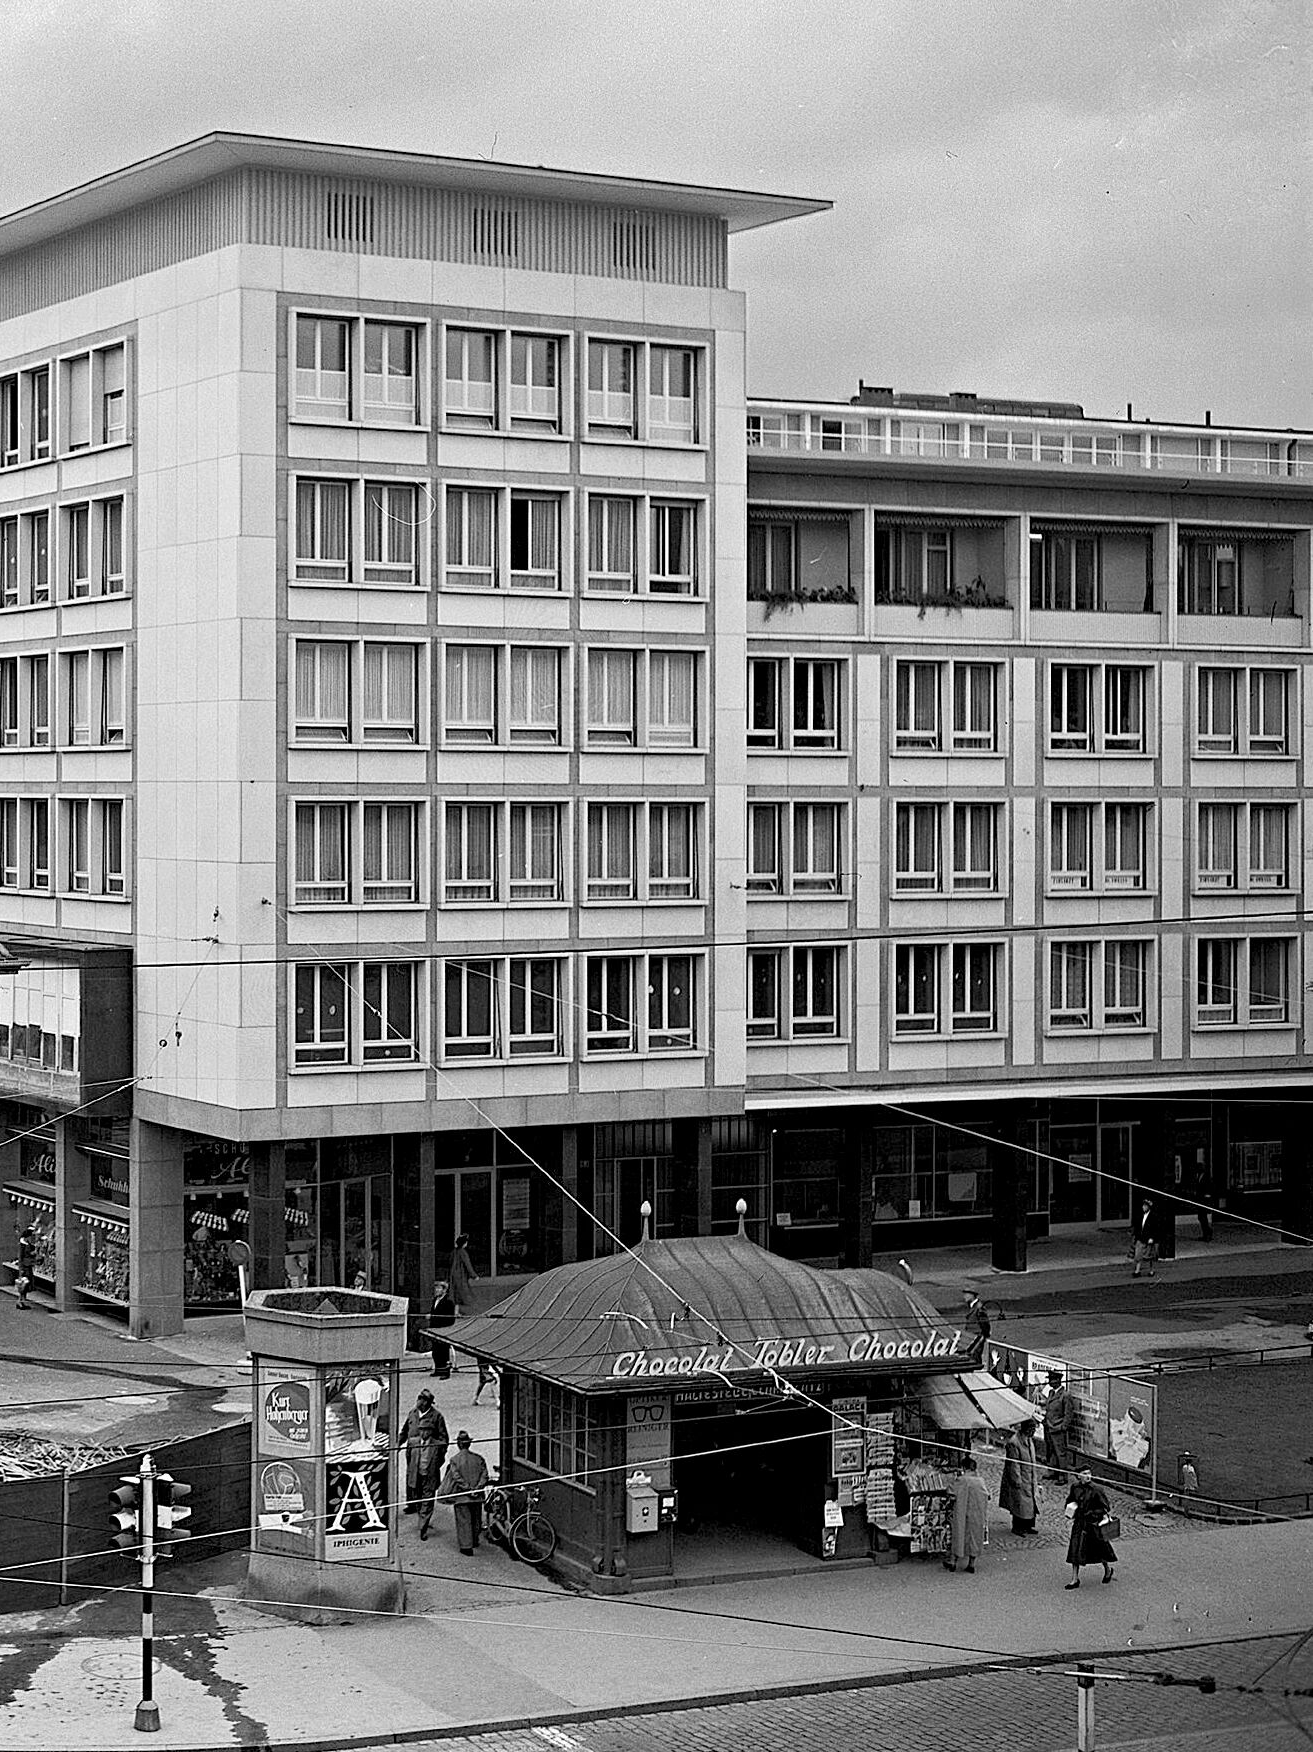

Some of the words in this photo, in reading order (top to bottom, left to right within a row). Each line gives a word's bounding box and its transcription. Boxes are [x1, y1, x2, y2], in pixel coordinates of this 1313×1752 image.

[612, 1346, 734, 1376] Chocolat
[752, 1335, 835, 1369] Tobler
[846, 1330, 962, 1362] Chocolat
[332, 1537, 381, 1548] IPHIGENIE
